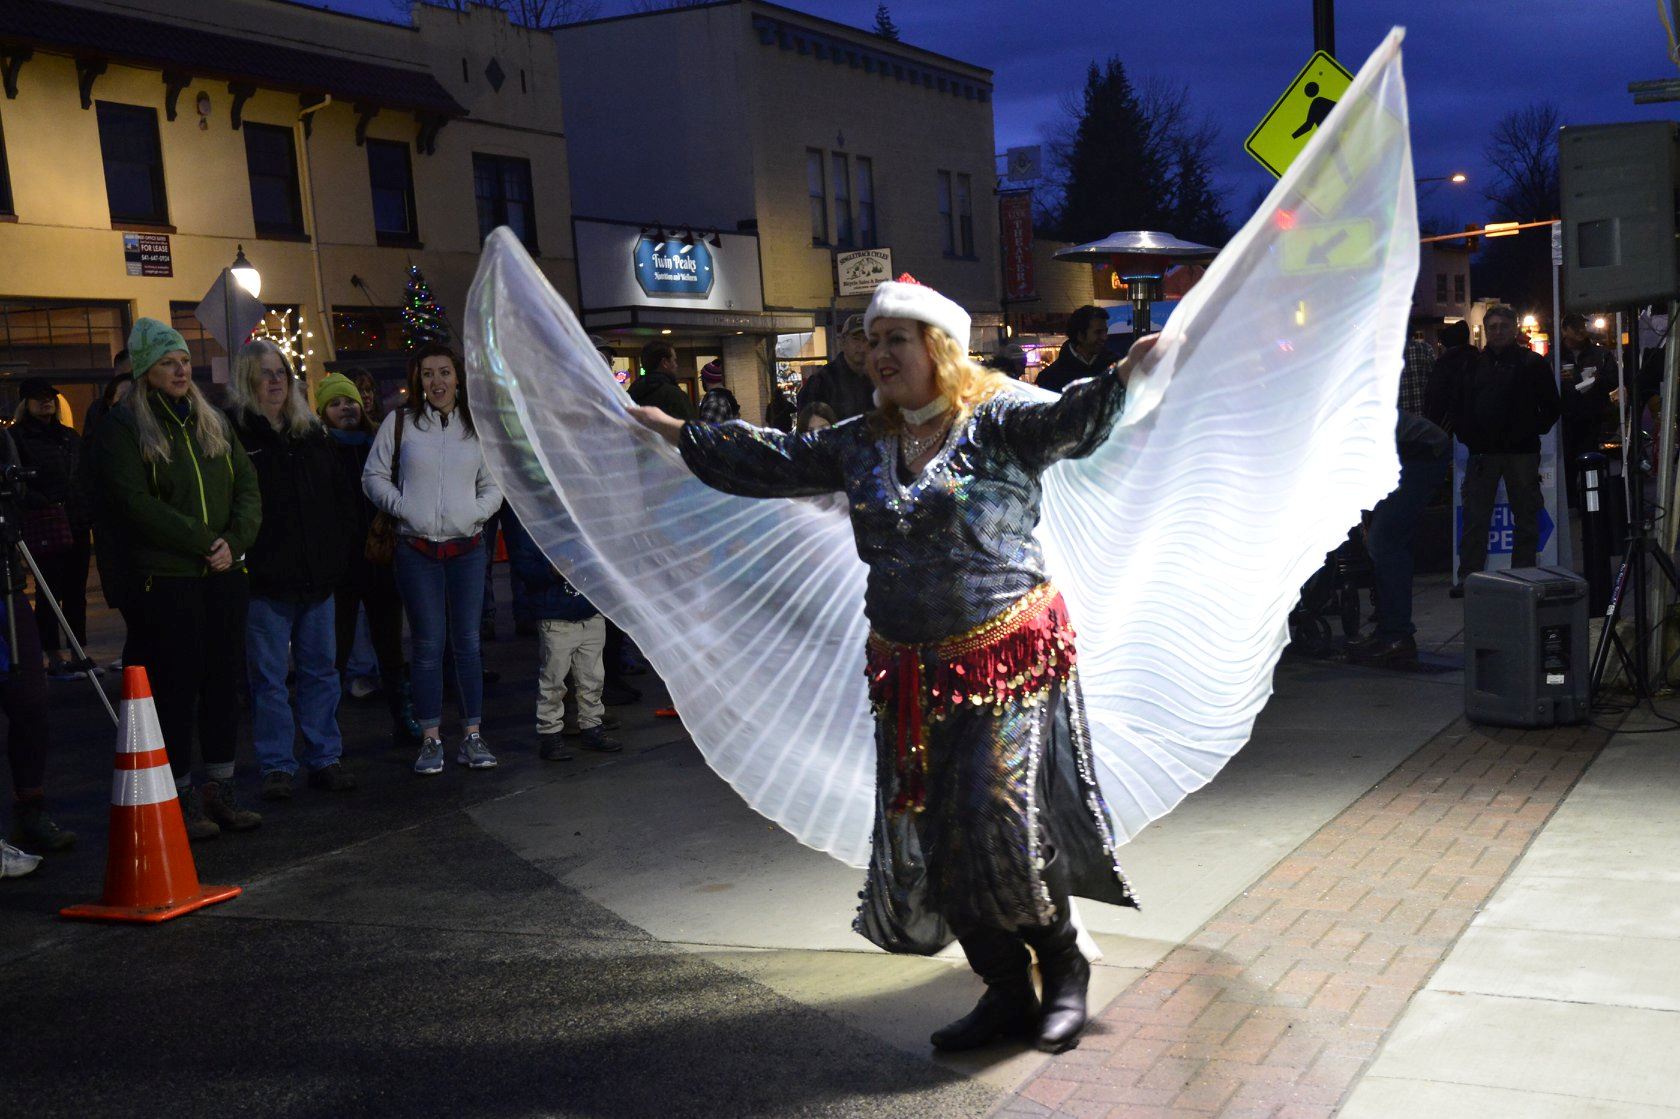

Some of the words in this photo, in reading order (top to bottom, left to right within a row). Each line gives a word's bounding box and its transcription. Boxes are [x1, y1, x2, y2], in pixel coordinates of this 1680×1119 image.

[871, 251, 889, 260] CYCLES
[652, 254, 672, 269] Twin
[672, 255, 697, 273] Peaks
